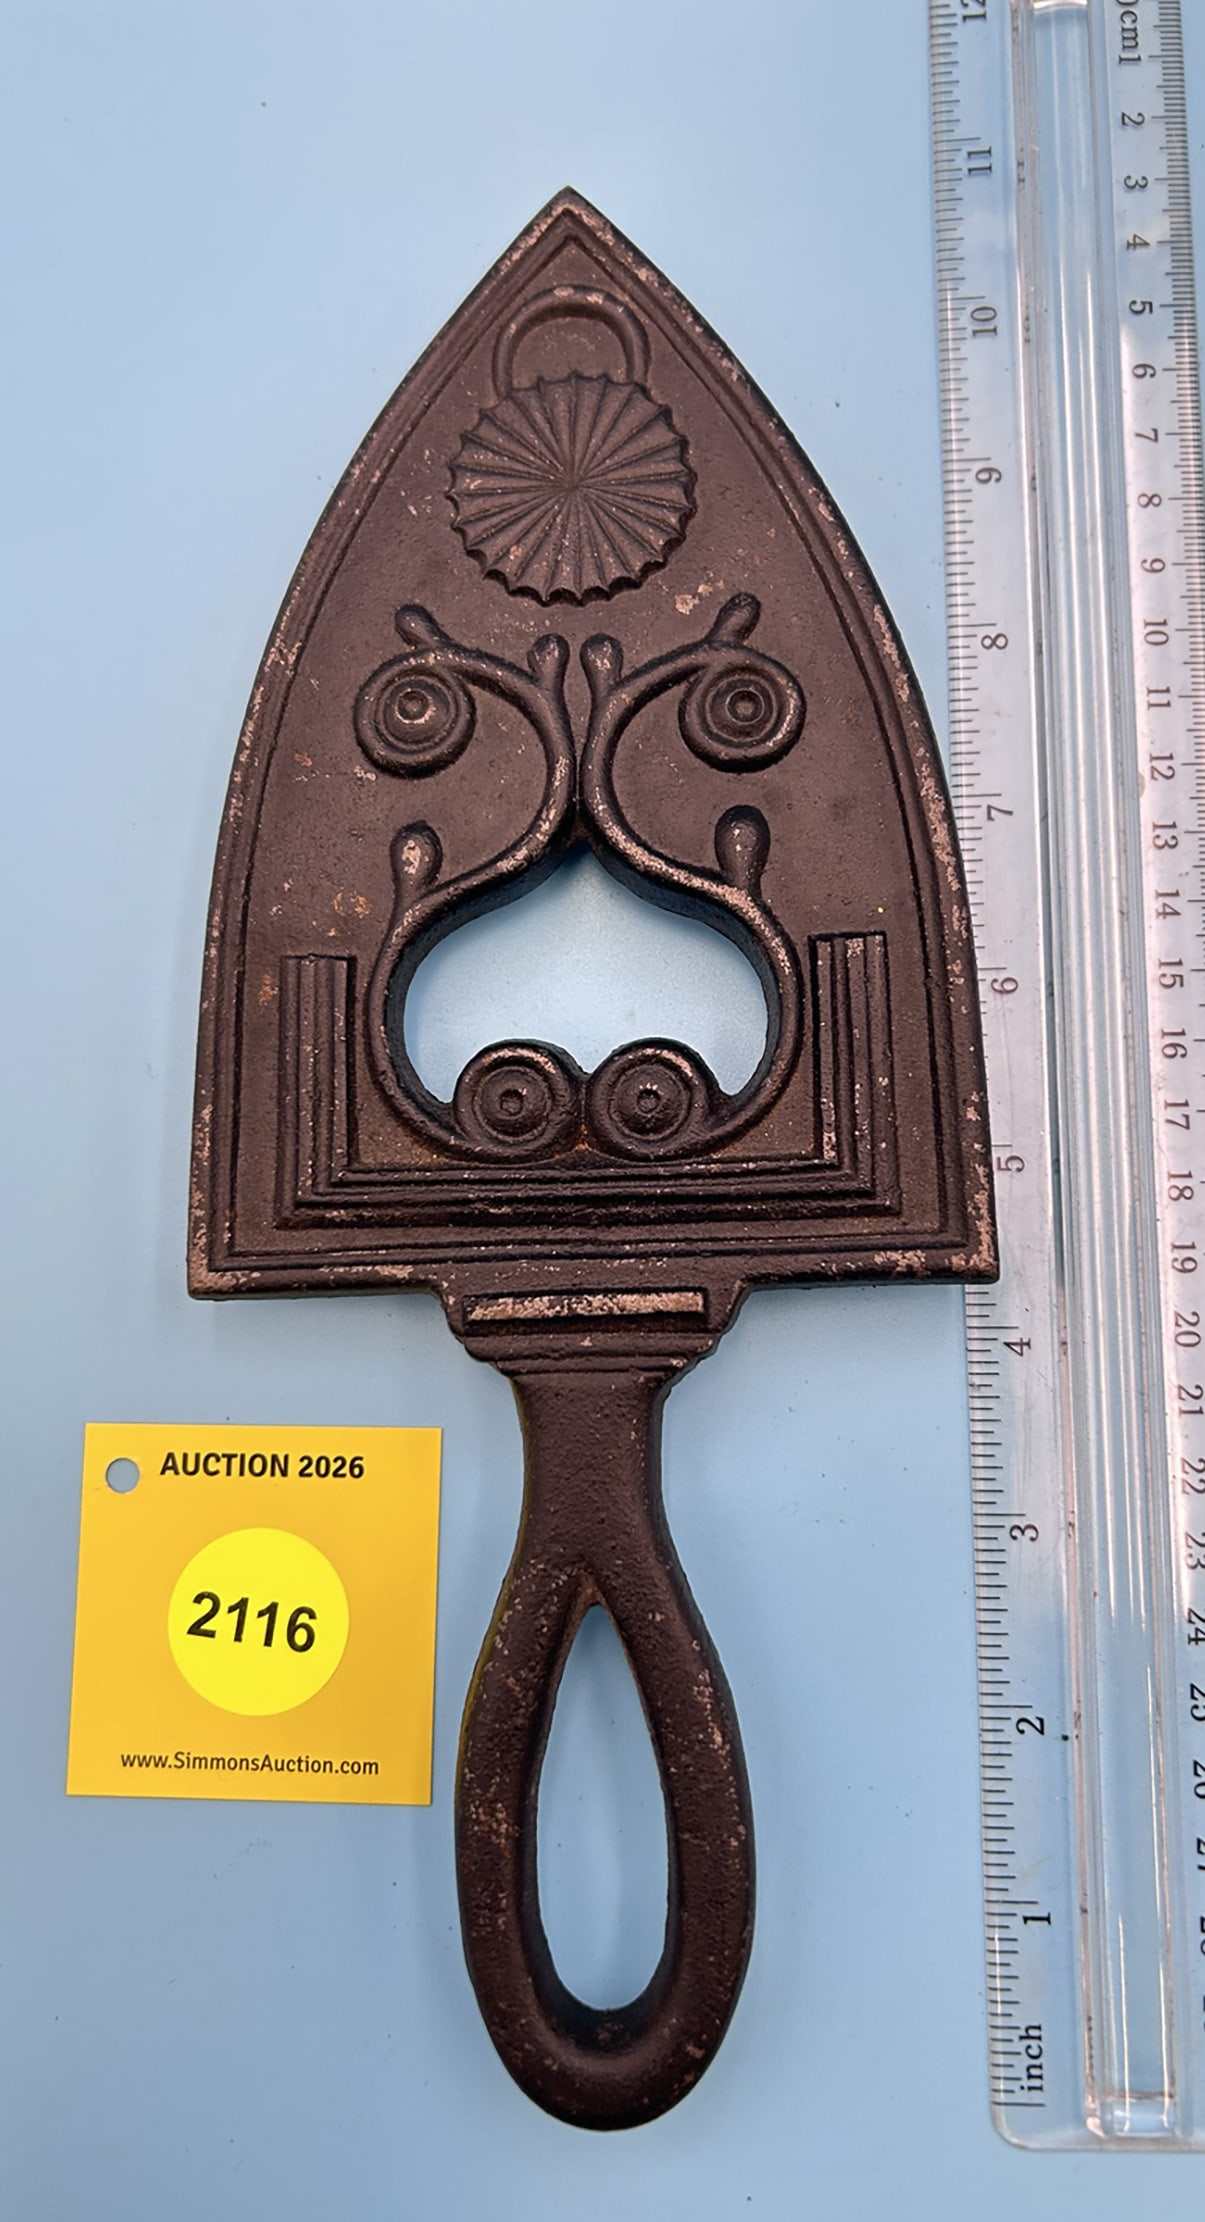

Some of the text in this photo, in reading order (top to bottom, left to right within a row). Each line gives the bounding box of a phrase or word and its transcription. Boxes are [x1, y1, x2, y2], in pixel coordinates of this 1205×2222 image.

[1121, 112, 1145, 127] 2
[966, 146, 993, 176] 11
[1123, 175, 1149, 191] 3
[1125, 233, 1151, 252] 4
[1128, 300, 1154, 316] 5
[970, 306, 998, 337] 10
[1133, 363, 1157, 379] 6
[1135, 427, 1159, 443] 7
[975, 466, 1003, 485] 9
[1138, 493, 1163, 509] 8
[1141, 557, 1166, 574] 9
[980, 632, 1009, 651] 8
[1144, 618, 1170, 647] 10
[1147, 686, 1172, 709] 11
[1149, 752, 1176, 781] 12
[986, 804, 1014, 822] 7
[1152, 821, 1179, 850] 13
[1156, 889, 1182, 920] 14
[1159, 958, 1185, 990] 15
[990, 977, 1019, 996] 6
[1161, 1028, 1188, 1059] 16
[1164, 1099, 1191, 1131] 17
[996, 1155, 1025, 1173] 5
[1168, 1170, 1195, 1202] 18
[1171, 1241, 1198, 1274] 19
[1174, 1311, 1202, 1348] 20
[1002, 1337, 1032, 1357] 4
[1178, 1384, 1204, 1415] 21
[160, 1451, 365, 1479] AUCTION 2026
[1180, 1456, 1205, 1495] 22
[1009, 1524, 1039, 1542] 3
[186, 1590, 317, 1653] 2116
[1015, 1716, 1045, 1736] 2
[120, 1751, 379, 1775] www.SimmonsAuction.com
[1022, 1912, 1052, 1926] 1
[1018, 2024, 1044, 2092] inch
